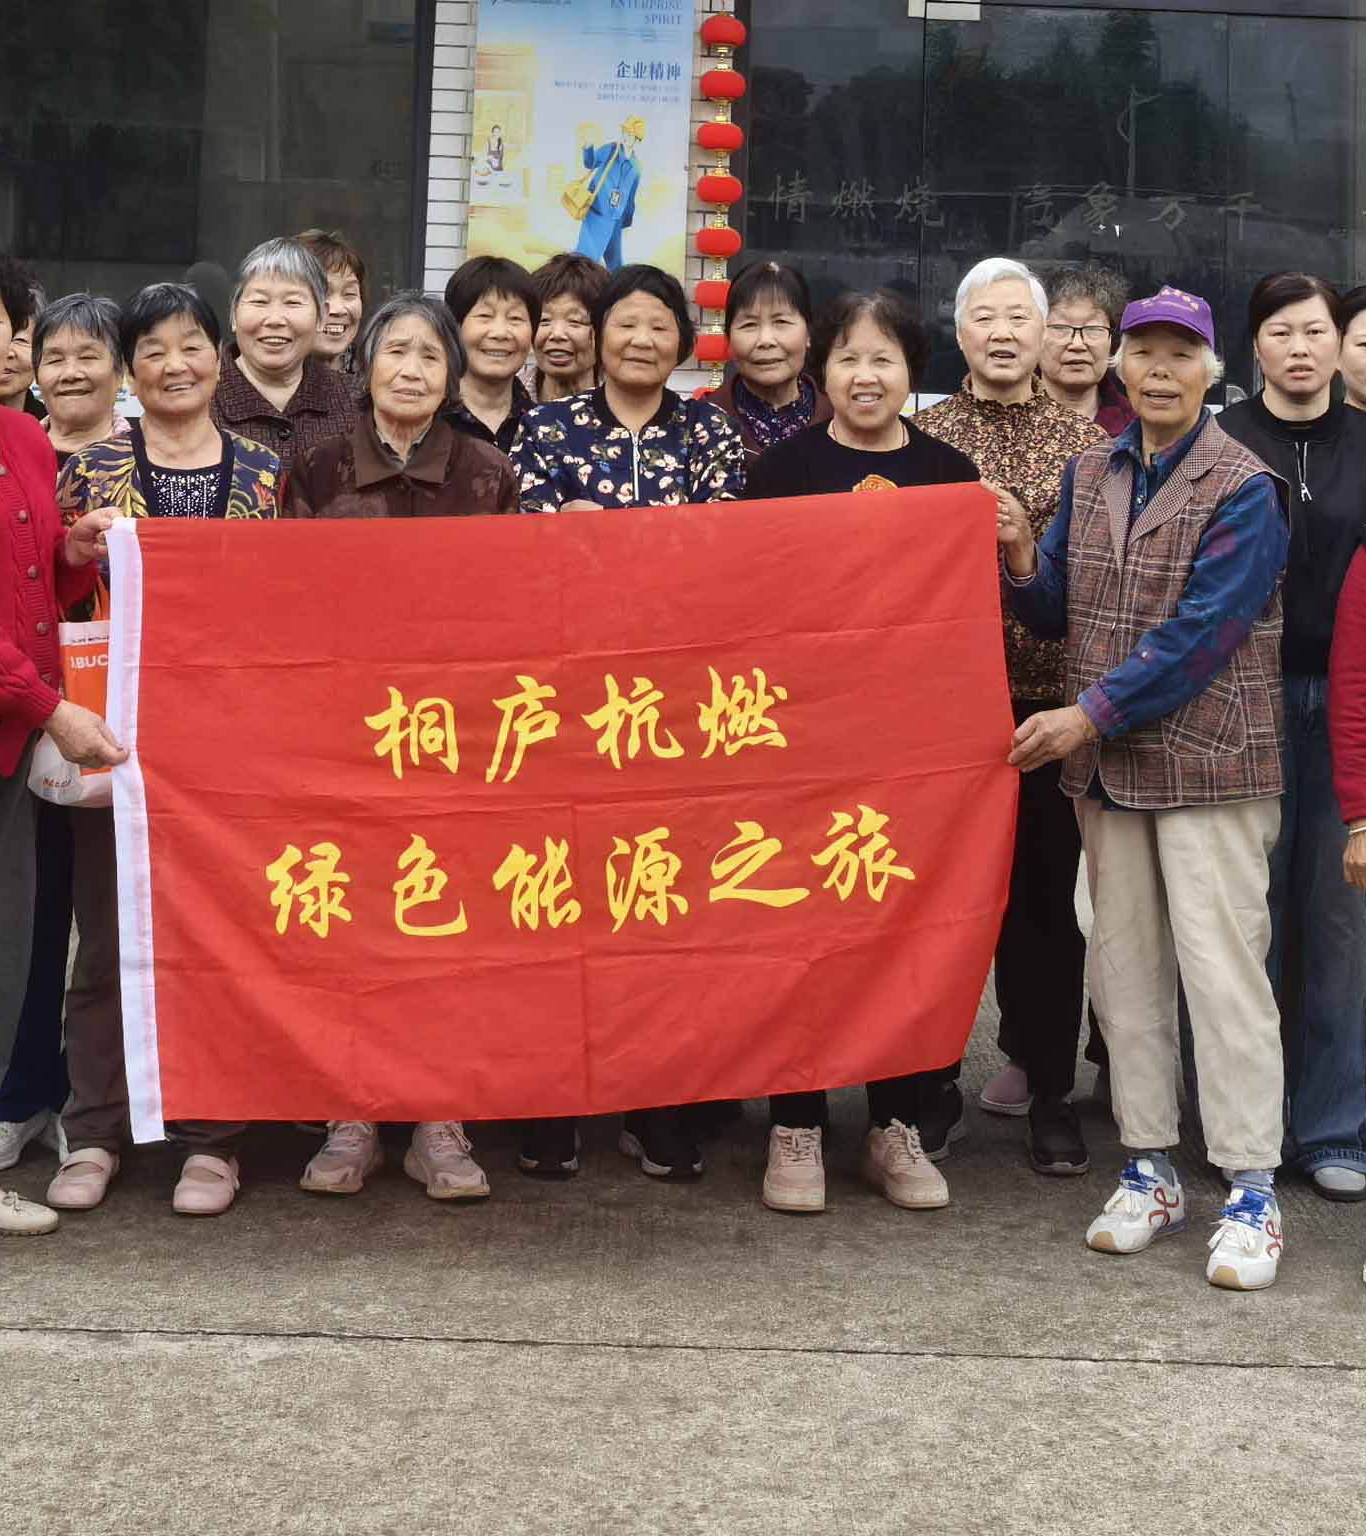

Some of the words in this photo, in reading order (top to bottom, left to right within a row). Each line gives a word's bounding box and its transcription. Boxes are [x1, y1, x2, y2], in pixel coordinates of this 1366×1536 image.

[644, 14, 683, 25] SPIRIT
[617, 60, 681, 81] 企业精神
[364, 665, 789, 783] 桐庐杭燃
[267, 804, 916, 939] 绿色能源之旅
